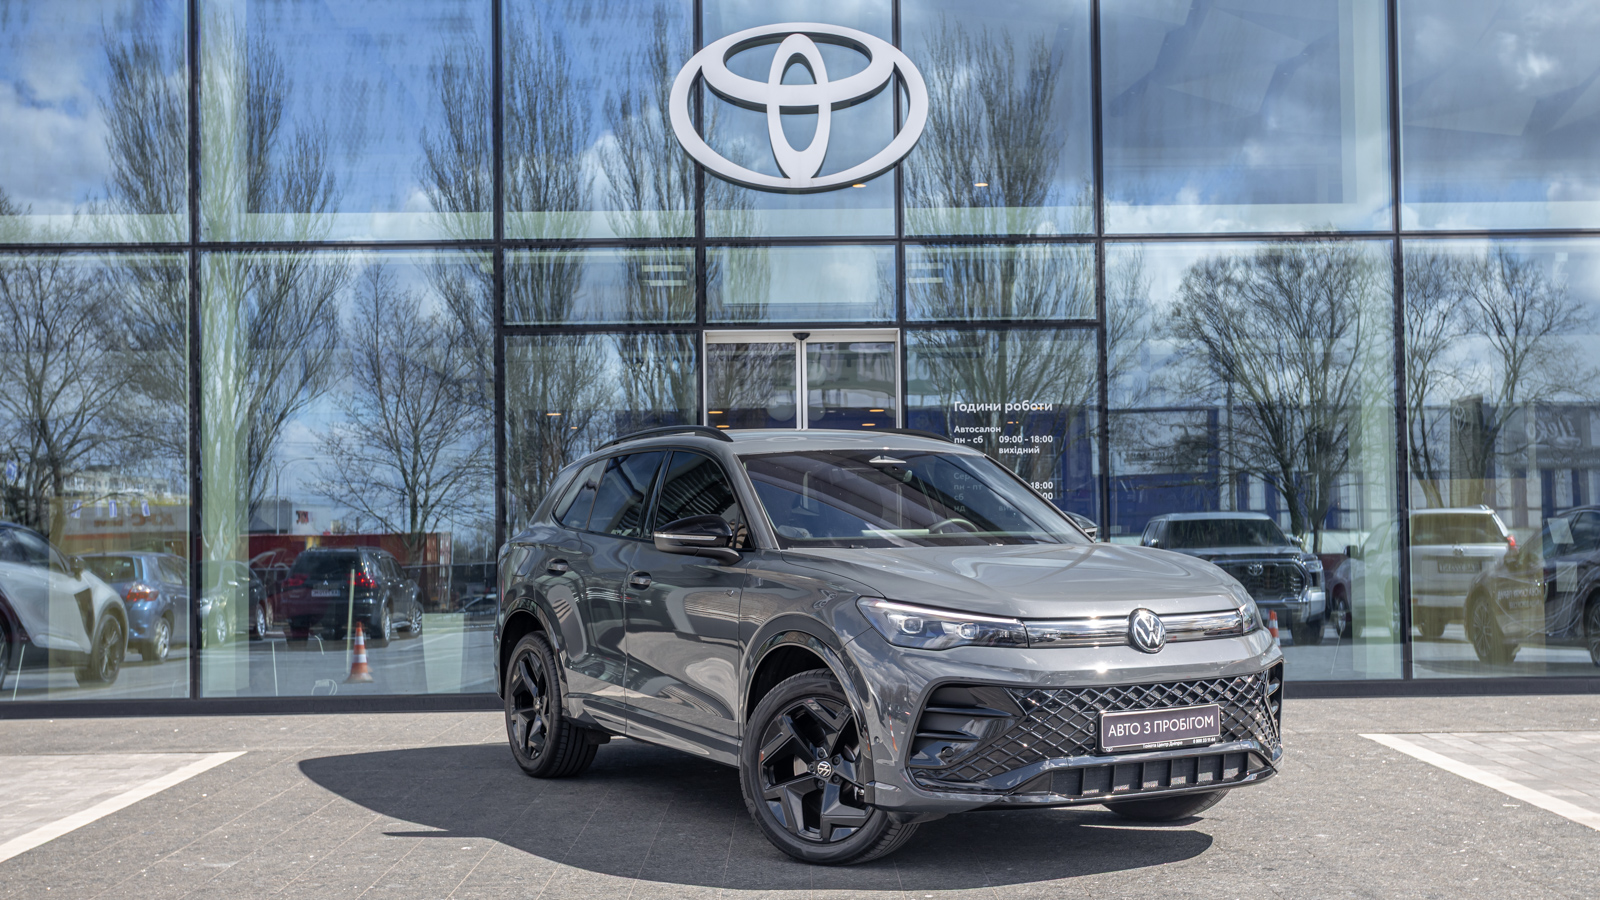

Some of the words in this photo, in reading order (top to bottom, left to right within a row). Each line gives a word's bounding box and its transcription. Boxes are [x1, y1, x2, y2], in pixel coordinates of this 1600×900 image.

[954, 401, 1001, 413] Години
[1005, 400, 1053, 414] роботи
[954, 425, 1002, 433] Автосалон
[973, 435, 984, 444] сб
[999, 435, 1023, 443] 09:00
[1030, 435, 1053, 443] 18:00
[999, 446, 1040, 454] вихідний
[1108, 722, 1141, 738] АВТО
[1143, 721, 1151, 735] З
[1154, 714, 1214, 734] ПРОБІГОМ
